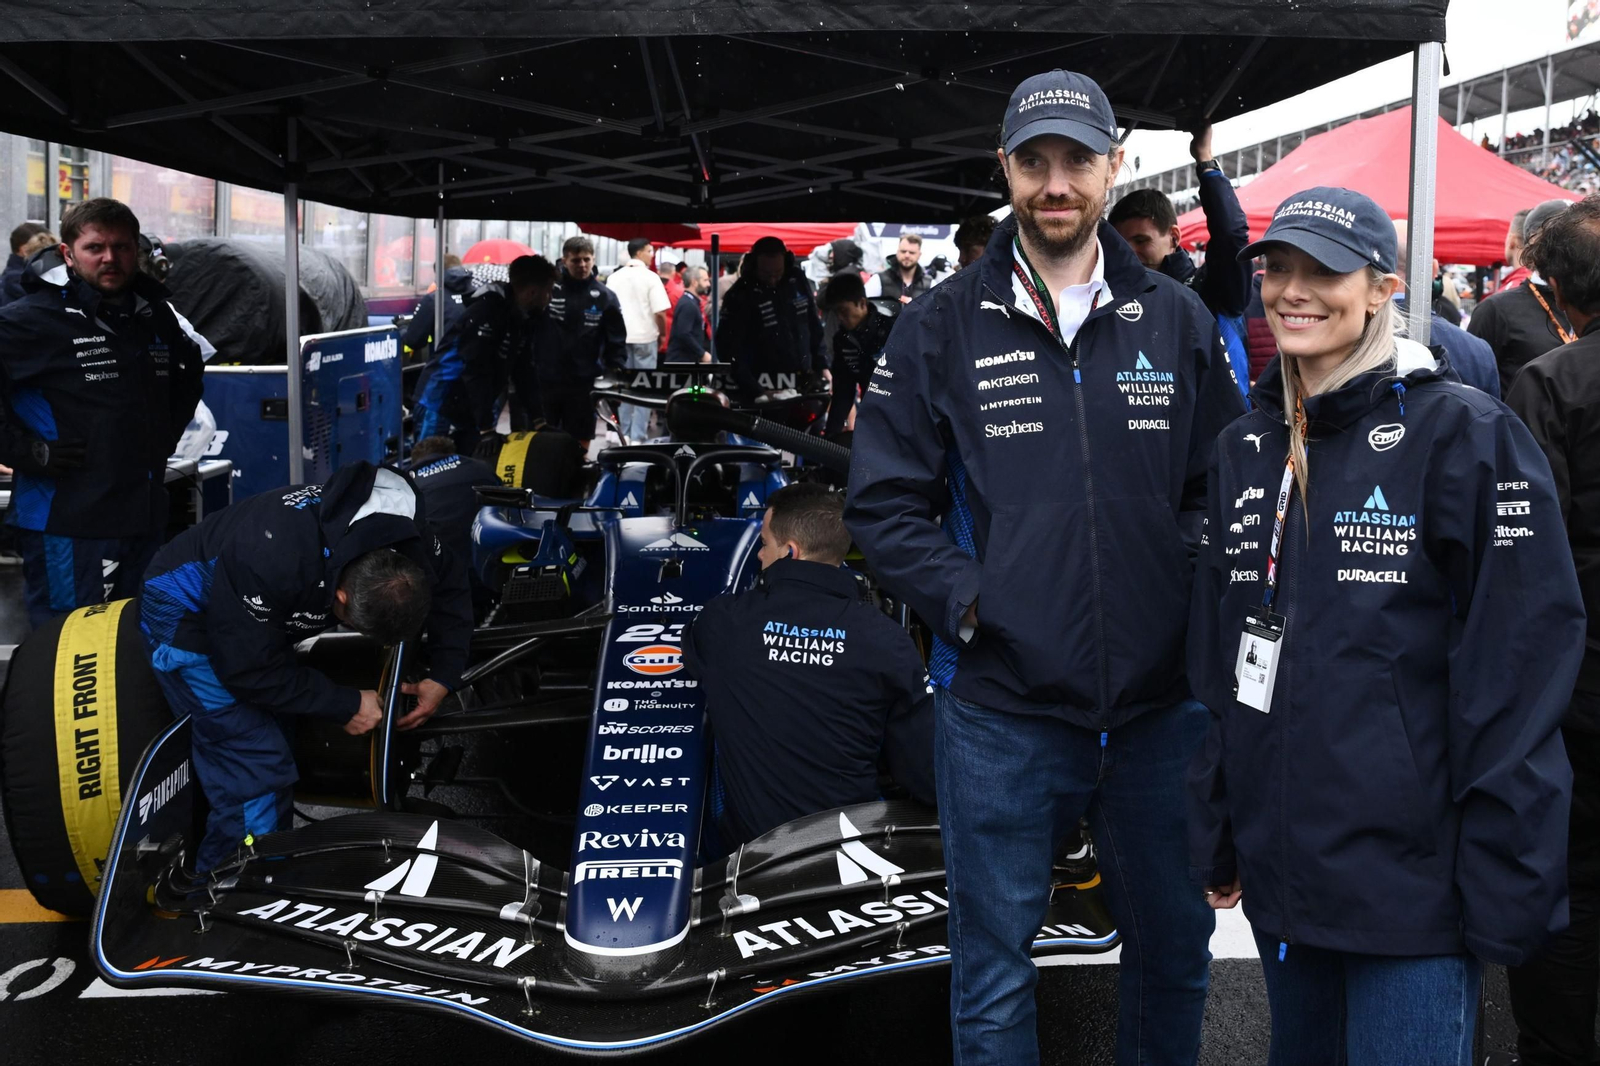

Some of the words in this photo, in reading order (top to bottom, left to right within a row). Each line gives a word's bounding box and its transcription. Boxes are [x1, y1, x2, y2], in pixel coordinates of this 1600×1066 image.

[1027, 89, 1090, 103] ATLASSIAN
[1018, 99, 1057, 113] WILLIAMS
[1058, 98, 1091, 110] RACING
[1286, 200, 1356, 222] ATLASSIAN
[1314, 210, 1353, 228] RACING
[73, 335, 106, 344] KOMATSU
[364, 334, 398, 363] KOMATSU
[975, 350, 1036, 368] KOMATSU
[85, 371, 119, 381] Stephens
[1116, 371, 1174, 382] ATLASSIAN
[1118, 383, 1175, 394] WILLIAMS
[989, 396, 1043, 409] MYPROTEIN
[1128, 395, 1170, 406] RACING
[985, 420, 1044, 438] Stephens
[1128, 419, 1170, 430] DURACELL
[1371, 430, 1403, 442] Gulf
[1497, 481, 1529, 491] EPER
[1278, 491, 1287, 511] GRID
[1496, 500, 1530, 516] ELLI
[1333, 511, 1416, 527] ATLASSIAN
[1333, 525, 1417, 542] WILLIAMS
[1341, 540, 1409, 556] RACING
[1337, 568, 1408, 584] DURACELL
[617, 604, 704, 613] Santande
[763, 621, 846, 640] ATLASSIAN
[763, 633, 845, 654] WILLIAMS
[768, 648, 834, 667] RACING
[73, 652, 98, 721] FRONT
[606, 679, 698, 689] KOMATSU
[634, 703, 696, 711] INGENUITY
[75, 729, 102, 801] RIGHT
[623, 777, 691, 788] VAST
[606, 804, 688, 814] KEEPER
[578, 828, 685, 853] Reviva
[574, 858, 684, 886] PIRELLI
[606, 897, 644, 923] W
[732, 887, 949, 959] ATLASSI
[236, 899, 536, 968] ATLASSIAN
[181, 957, 490, 1006] MYPROTEIN
